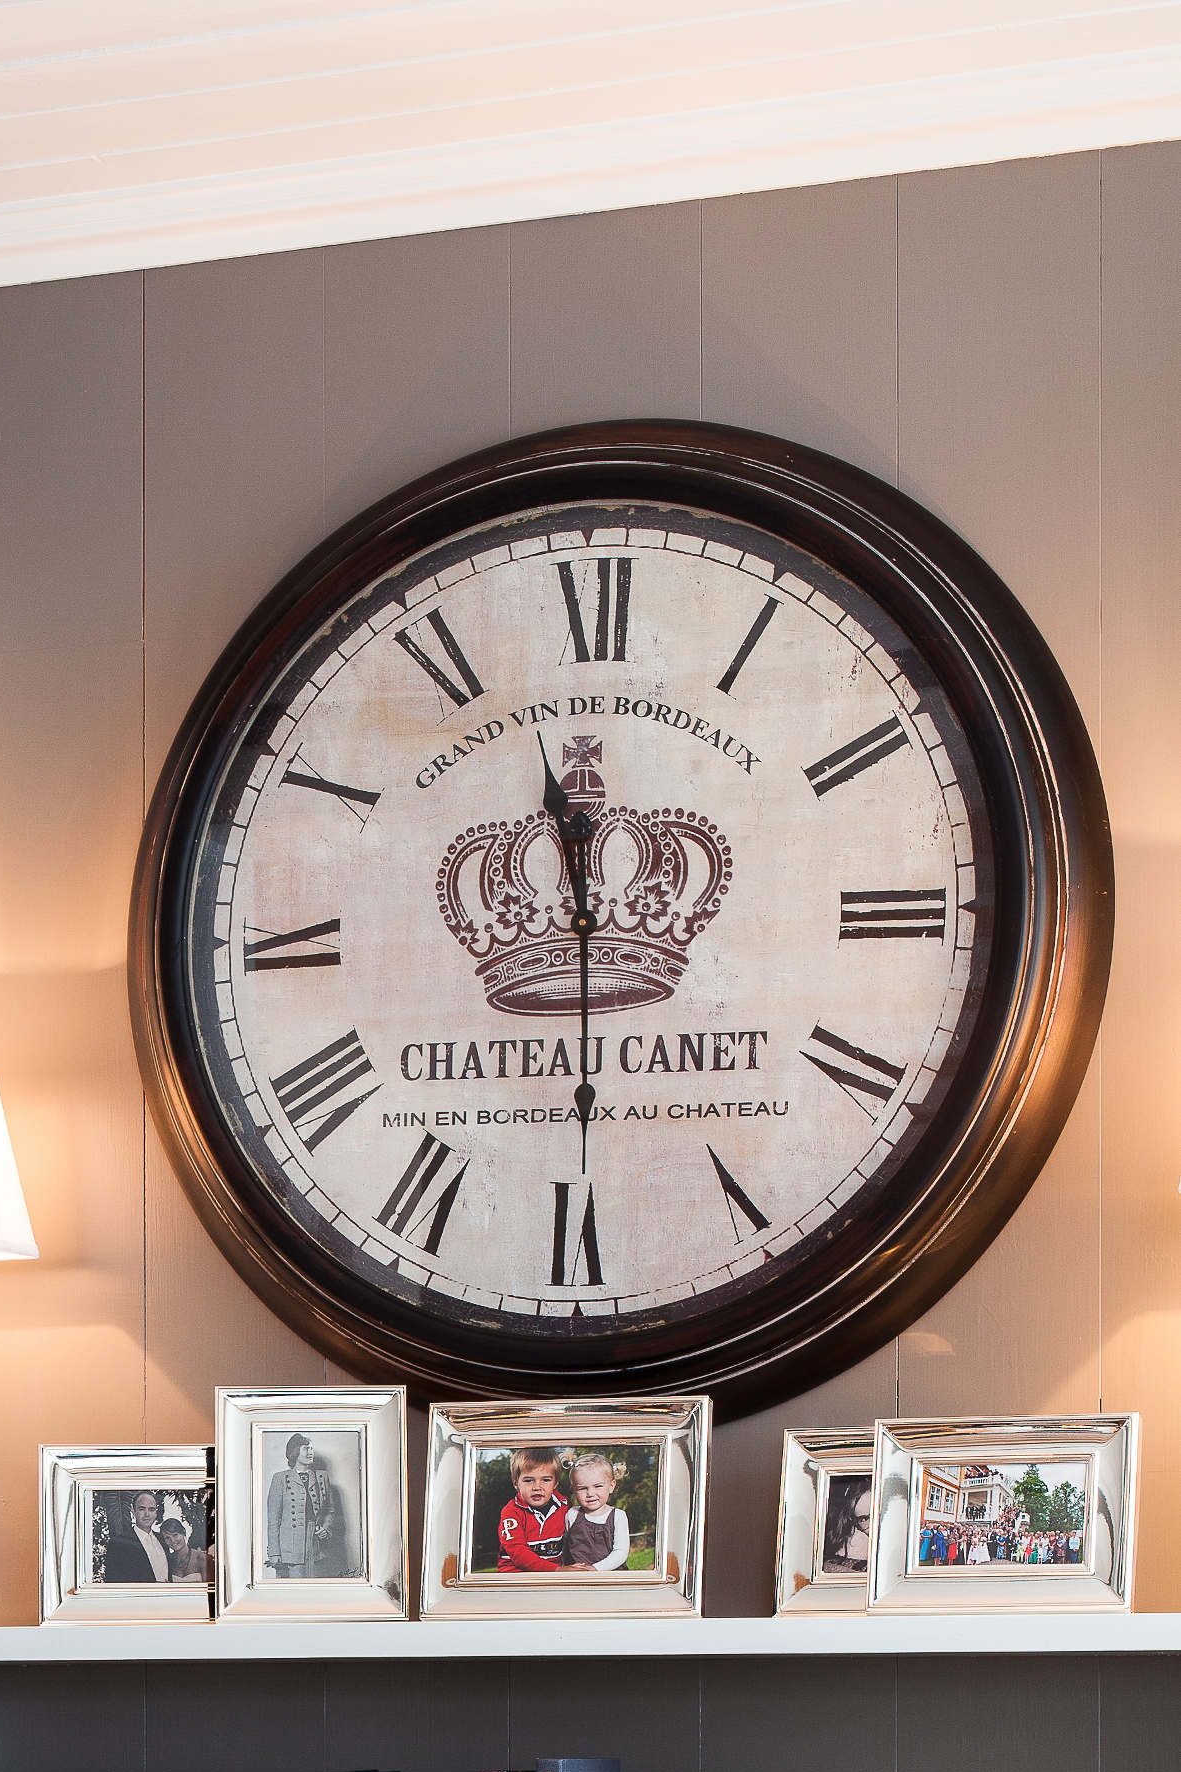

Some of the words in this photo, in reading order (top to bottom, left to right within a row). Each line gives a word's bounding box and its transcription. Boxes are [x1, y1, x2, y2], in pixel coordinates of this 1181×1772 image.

[716, 595, 783, 695] I
[414, 718, 508, 791] GRAND
[508, 701, 563, 734] VIN
[566, 695, 606, 716] DE
[612, 698, 763, 775] BORDEAUX
[400, 1037, 605, 1082] CHATEAU
[619, 1030, 769, 1072] CANET
[381, 1111, 429, 1129] MIN
[434, 1111, 468, 1127] EN
[476, 1106, 617, 1125] BORDEAUX
[628, 1104, 660, 1121] AU
[666, 1099, 790, 1119] CHATEAU
[500, 1518, 518, 1541] P
